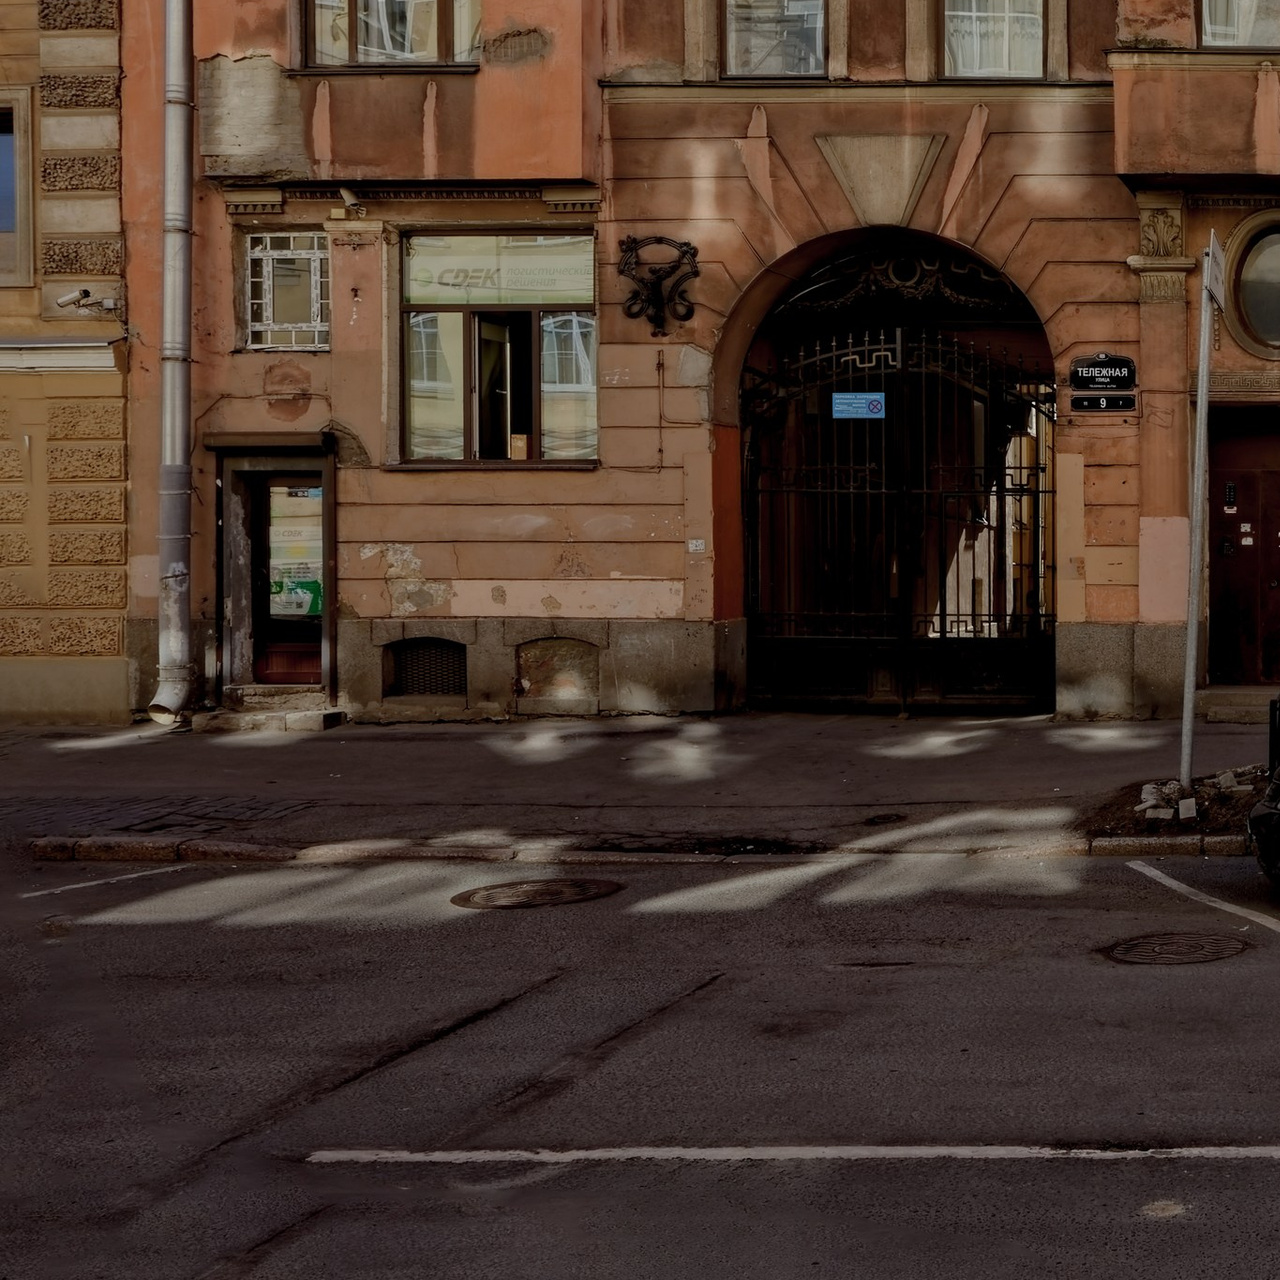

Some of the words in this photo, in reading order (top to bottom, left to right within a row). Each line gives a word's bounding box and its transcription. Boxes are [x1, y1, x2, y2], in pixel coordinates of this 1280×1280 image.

[506, 266, 592, 276] логистические
[506, 277, 556, 288] решения
[1077, 367, 1128, 377] ТЕЛЕЖНАЯ
[1100, 397, 1107, 408] 9
